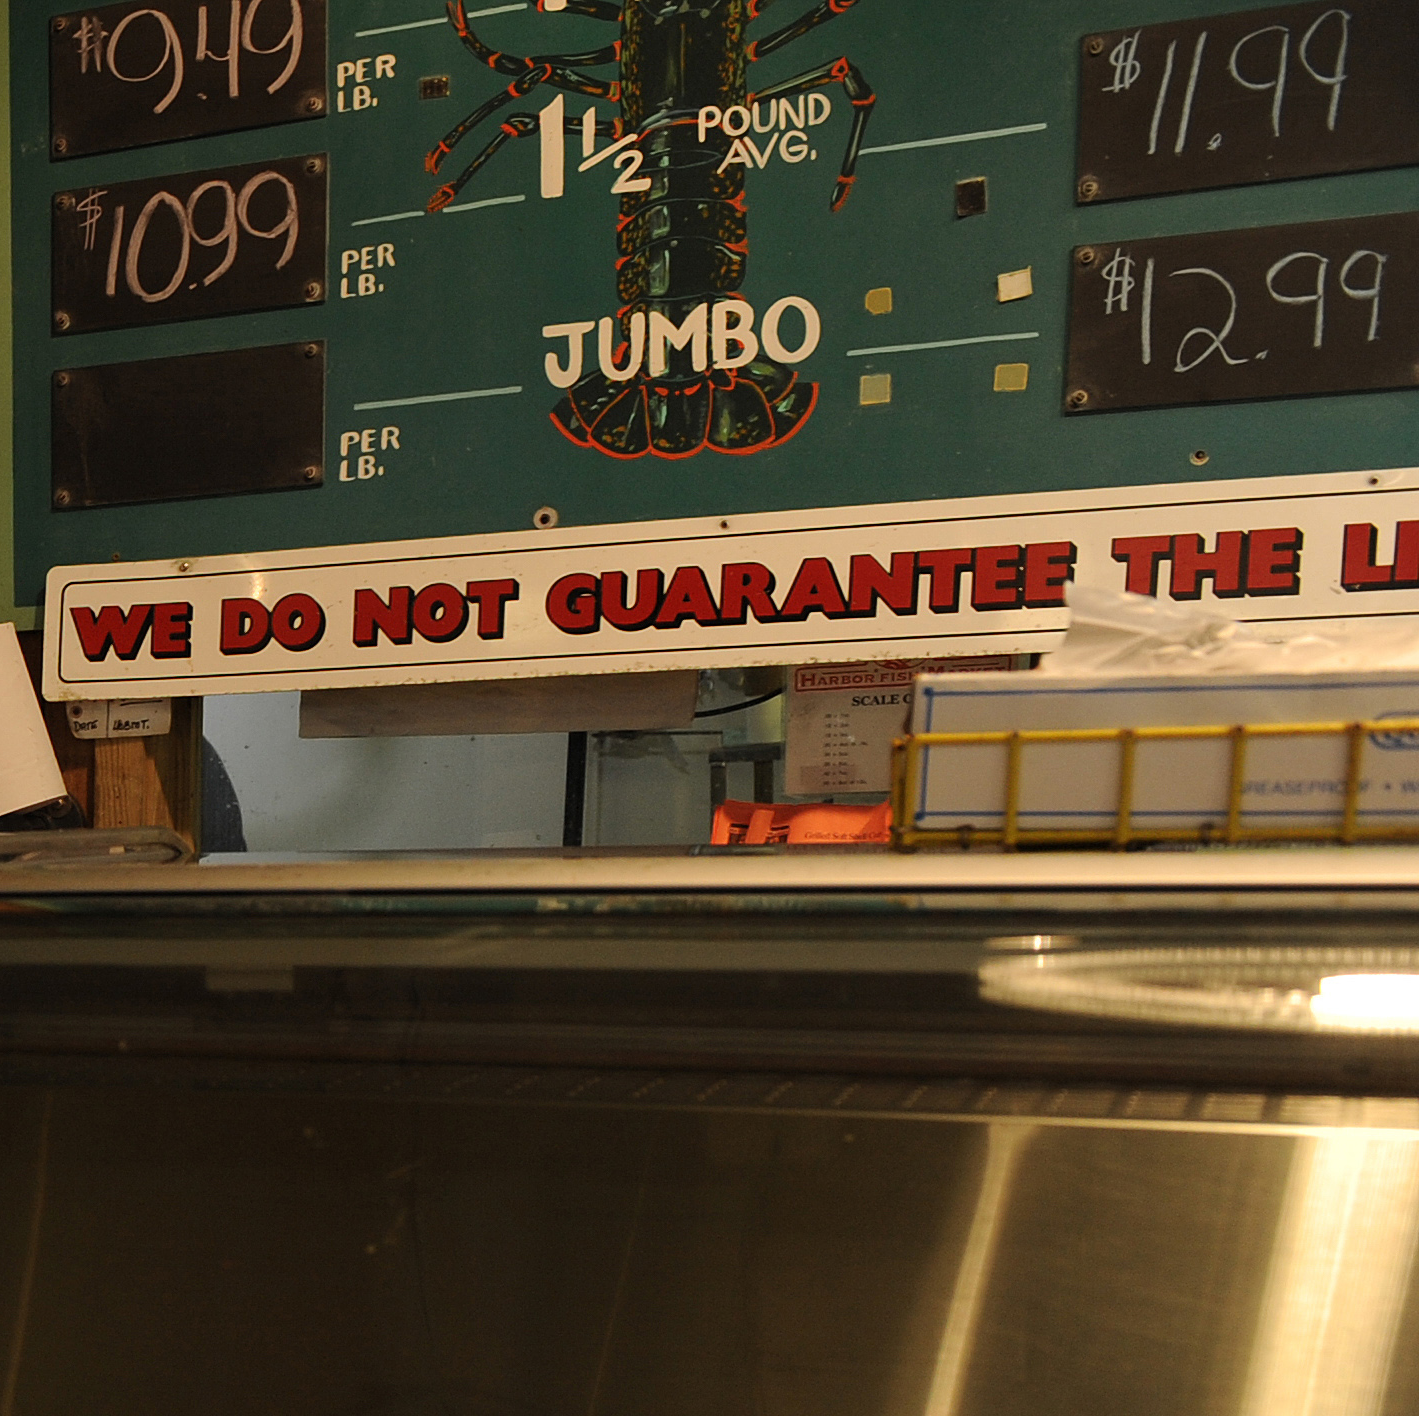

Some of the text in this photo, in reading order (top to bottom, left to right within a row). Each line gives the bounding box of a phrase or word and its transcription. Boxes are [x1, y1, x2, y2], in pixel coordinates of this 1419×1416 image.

[337, 55, 396, 87] PER
[1103, 9, 1354, 156] $11.99
[337, 86, 378, 113] LB.
[696, 92, 832, 143] POUND
[716, 136, 819, 175] AVG.
[75, 170, 298, 302] $10.99
[341, 243, 396, 275] PER
[340, 271, 385, 299] LB.
[1101, 247, 1388, 372] $12.99
[541, 294, 822, 389] JUMBO
[340, 426, 401, 453] PER
[339, 453, 385, 482] LB.
[69, 601, 193, 662] WE
[219, 592, 327, 655] DO
[352, 578, 520, 647] NOT
[545, 540, 1079, 636] GUARANTEE
[1111, 527, 1305, 601] THE
[799, 672, 873, 688] HARBOR
[851, 695, 899, 707] SCALE
